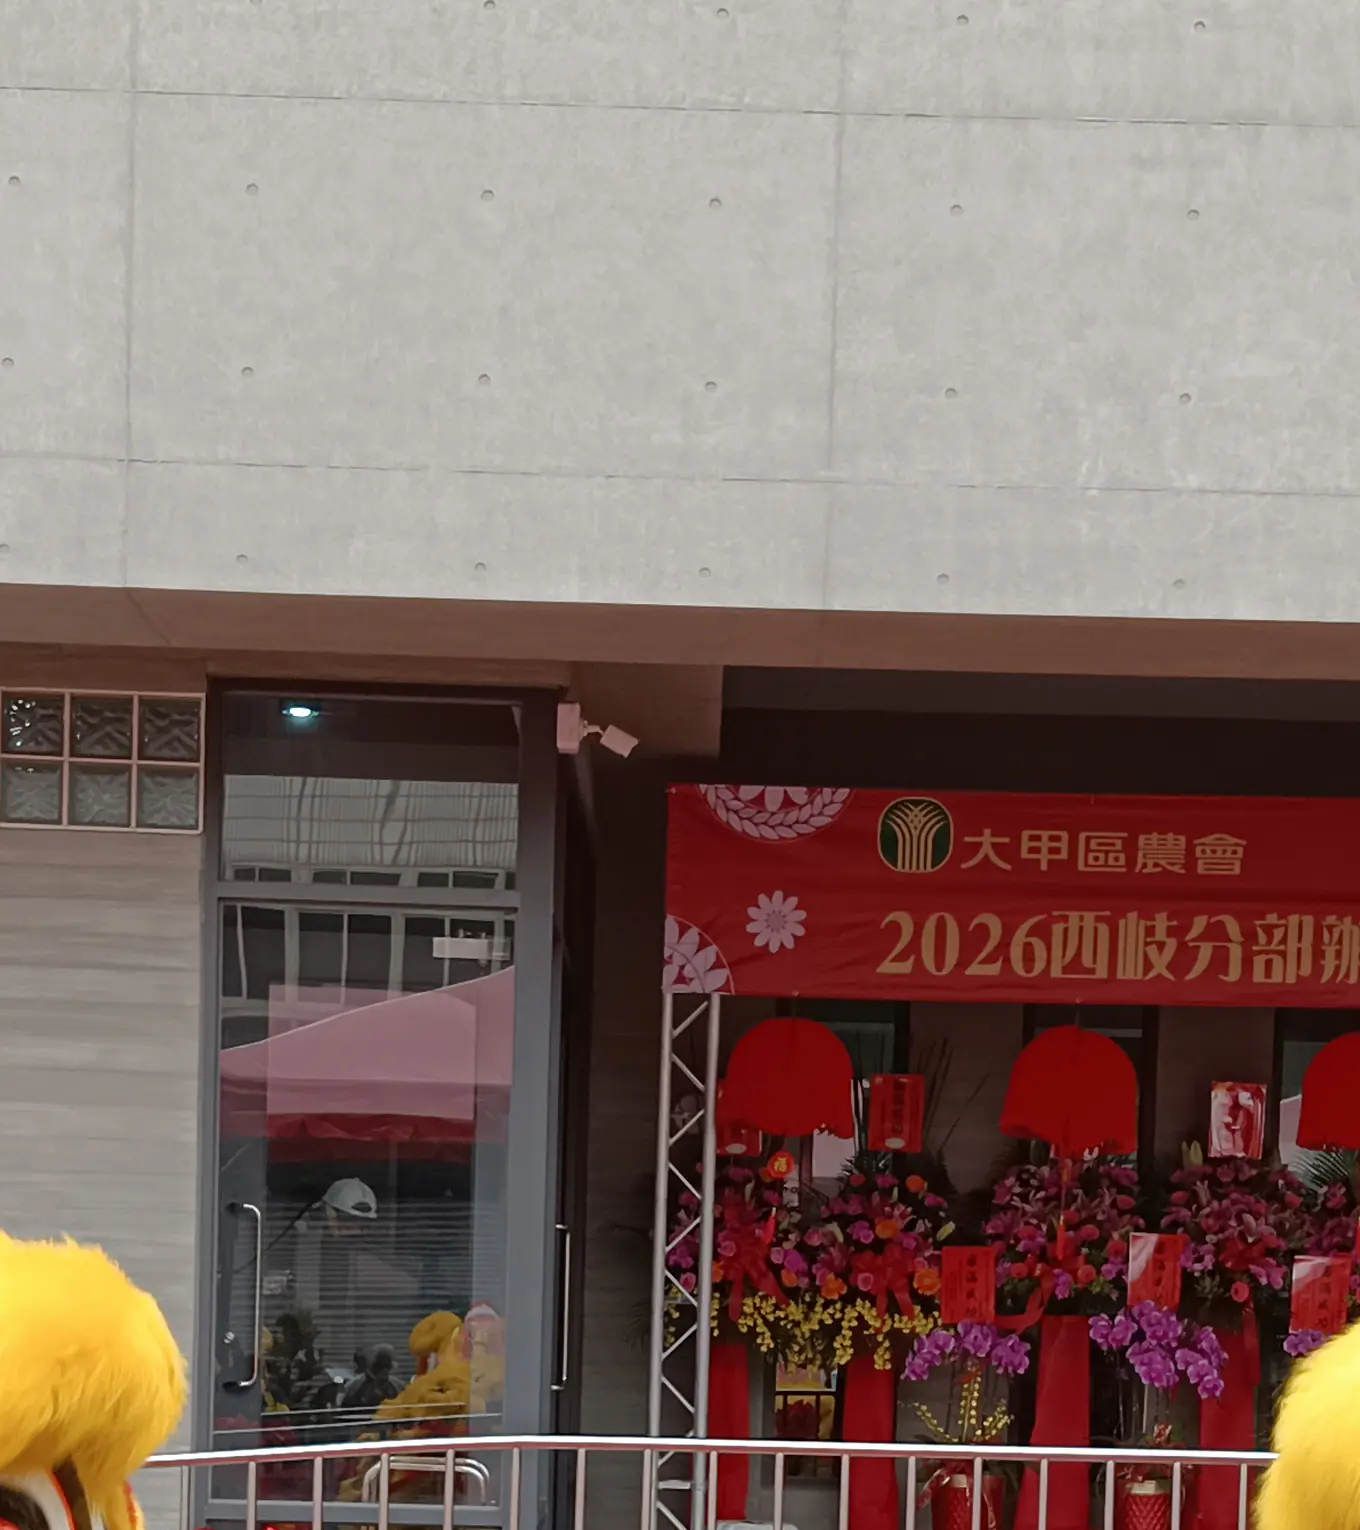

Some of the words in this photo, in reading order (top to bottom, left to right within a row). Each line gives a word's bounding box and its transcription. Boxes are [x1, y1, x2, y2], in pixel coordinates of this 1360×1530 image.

[960, 828, 1247, 876] 大甲區農會
